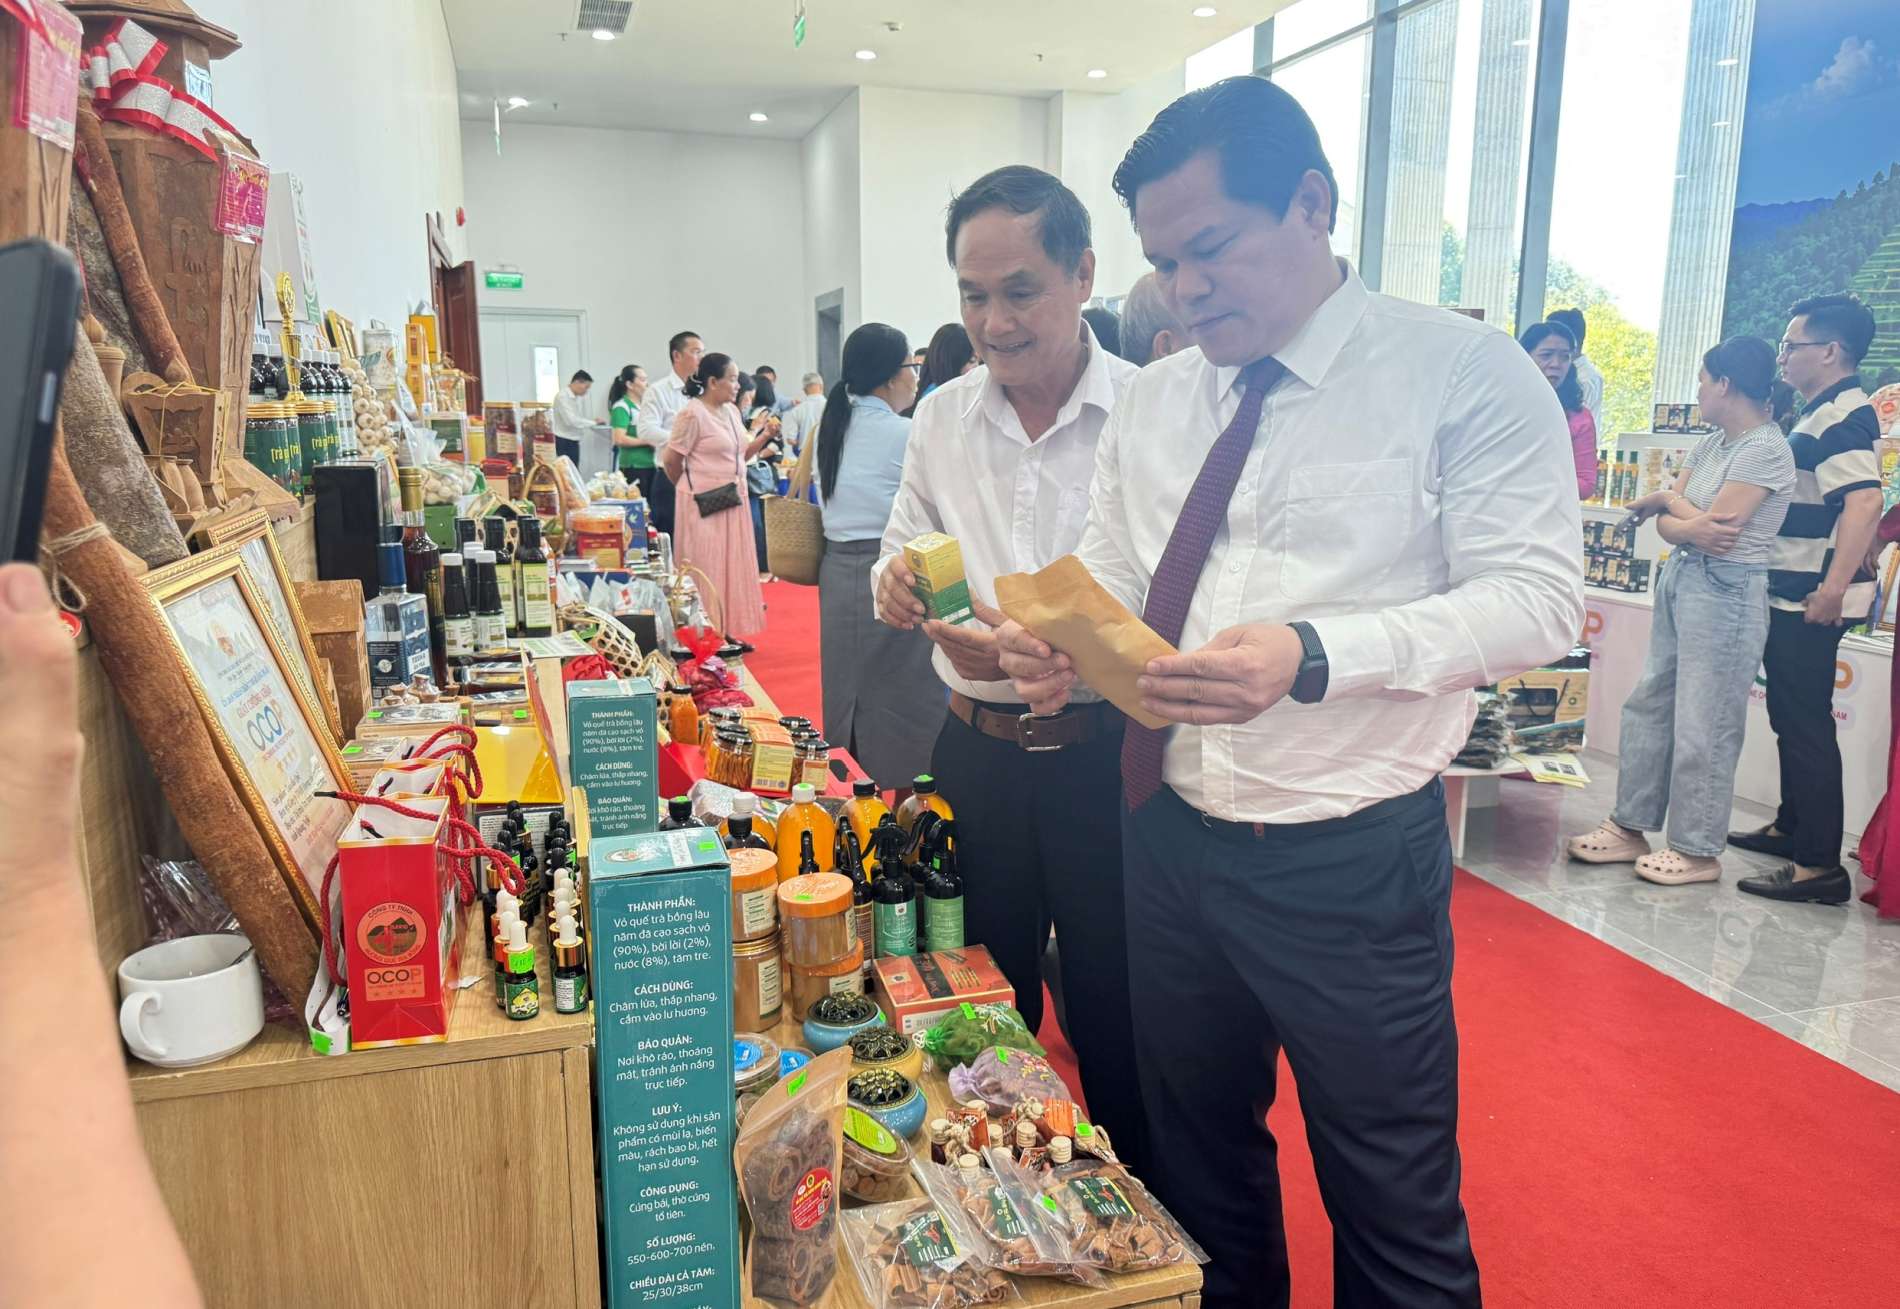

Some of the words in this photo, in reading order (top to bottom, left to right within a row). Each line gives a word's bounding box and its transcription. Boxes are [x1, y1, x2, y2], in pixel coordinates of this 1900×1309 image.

[627, 900, 662, 913] THÀNH
[665, 896, 696, 909] PHẦN:
[613, 917, 628, 928] Vỏ
[629, 914, 650, 928] quế
[651, 915, 665, 924] trà
[667, 911, 693, 922] bồng
[694, 910, 710, 919] lâu
[613, 932, 637, 943] năm
[638, 929, 651, 940] đã
[653, 928, 672, 938] cạo
[673, 924, 696, 935] sạch
[698, 922, 711, 934] vỏ
[613, 944, 650, 958] (90%),
[651, 942, 667, 952] bời
[669, 940, 681, 950] lời
[683, 936, 711, 950] (2%),
[614, 959, 640, 971] nước
[641, 954, 671, 968] (8%),
[673, 953, 692, 963] tăm
[694, 952, 711, 961] tre.
[367, 969, 421, 984] OCOP
[634, 983, 660, 996] CÁCH
[662, 979, 694, 991] DÙNG:
[609, 1002, 638, 1013] Châm
[640, 998, 658, 1009] lửa,
[660, 994, 683, 1006] thấp
[684, 992, 718, 1003] nhang,
[643, 1012, 662, 1021] vào
[675, 1006, 709, 1018] hương.
[638, 1038, 659, 1051] BẢO
[661, 1034, 693, 1047] QUẢN:
[617, 1055, 635, 1068] Nơi
[636, 1054, 655, 1064] khô
[657, 1052, 677, 1061] ráo,
[678, 1046, 713, 1058] thoáng
[616, 1070, 639, 1081] mát,
[641, 1065, 668, 1077] tránh
[670, 1062, 688, 1073] ánh
[690, 1059, 715, 1070] nắng
[645, 1081, 664, 1091] trực
[666, 1076, 688, 1088] tiếp.
[651, 1105, 671, 1116] LƯU
[672, 1102, 682, 1112] Ý:
[613, 1124, 645, 1136] Không
[647, 1120, 659, 1130] sử
[660, 1118, 686, 1130] dụng
[687, 1113, 702, 1122] khi
[703, 1110, 721, 1122] sản
[618, 1135, 647, 1150] phẩm
[648, 1134, 660, 1144] có
[662, 1130, 681, 1142] mùi
[682, 1129, 693, 1139] lạ,
[695, 1124, 717, 1136] biến
[618, 1150, 643, 1162] màu,
[645, 1147, 667, 1158] rách
[668, 1143, 687, 1154] bao
[688, 1140, 700, 1152] bì,
[701, 1137, 718, 1149] hết
[638, 1163, 657, 1173] hạn
[658, 1158, 670, 1169] sử
[672, 1155, 699, 1168] dụng.
[640, 1185, 667, 1198] CÔNG
[669, 1180, 699, 1194] DỤNG:
[629, 1202, 653, 1213] Cúng
[654, 1198, 670, 1209] bái,
[672, 1195, 687, 1206] thờ
[687, 1191, 710, 1203] cúng
[655, 1211, 665, 1222] tổ
[666, 1209, 686, 1220] tiên.
[646, 1235, 659, 1249] SỐ
[661, 1232, 696, 1246] LƯỢNG:
[627, 1245, 693, 1266] 550-600-700
[694, 1242, 716, 1253] nén.
[629, 1275, 657, 1290] CHIỀU
[658, 1273, 675, 1285] DÀI
[676, 1269, 689, 1281] CẢ
[691, 1266, 715, 1279] TĂM:
[642, 1281, 703, 1302] 25/30/38cm
